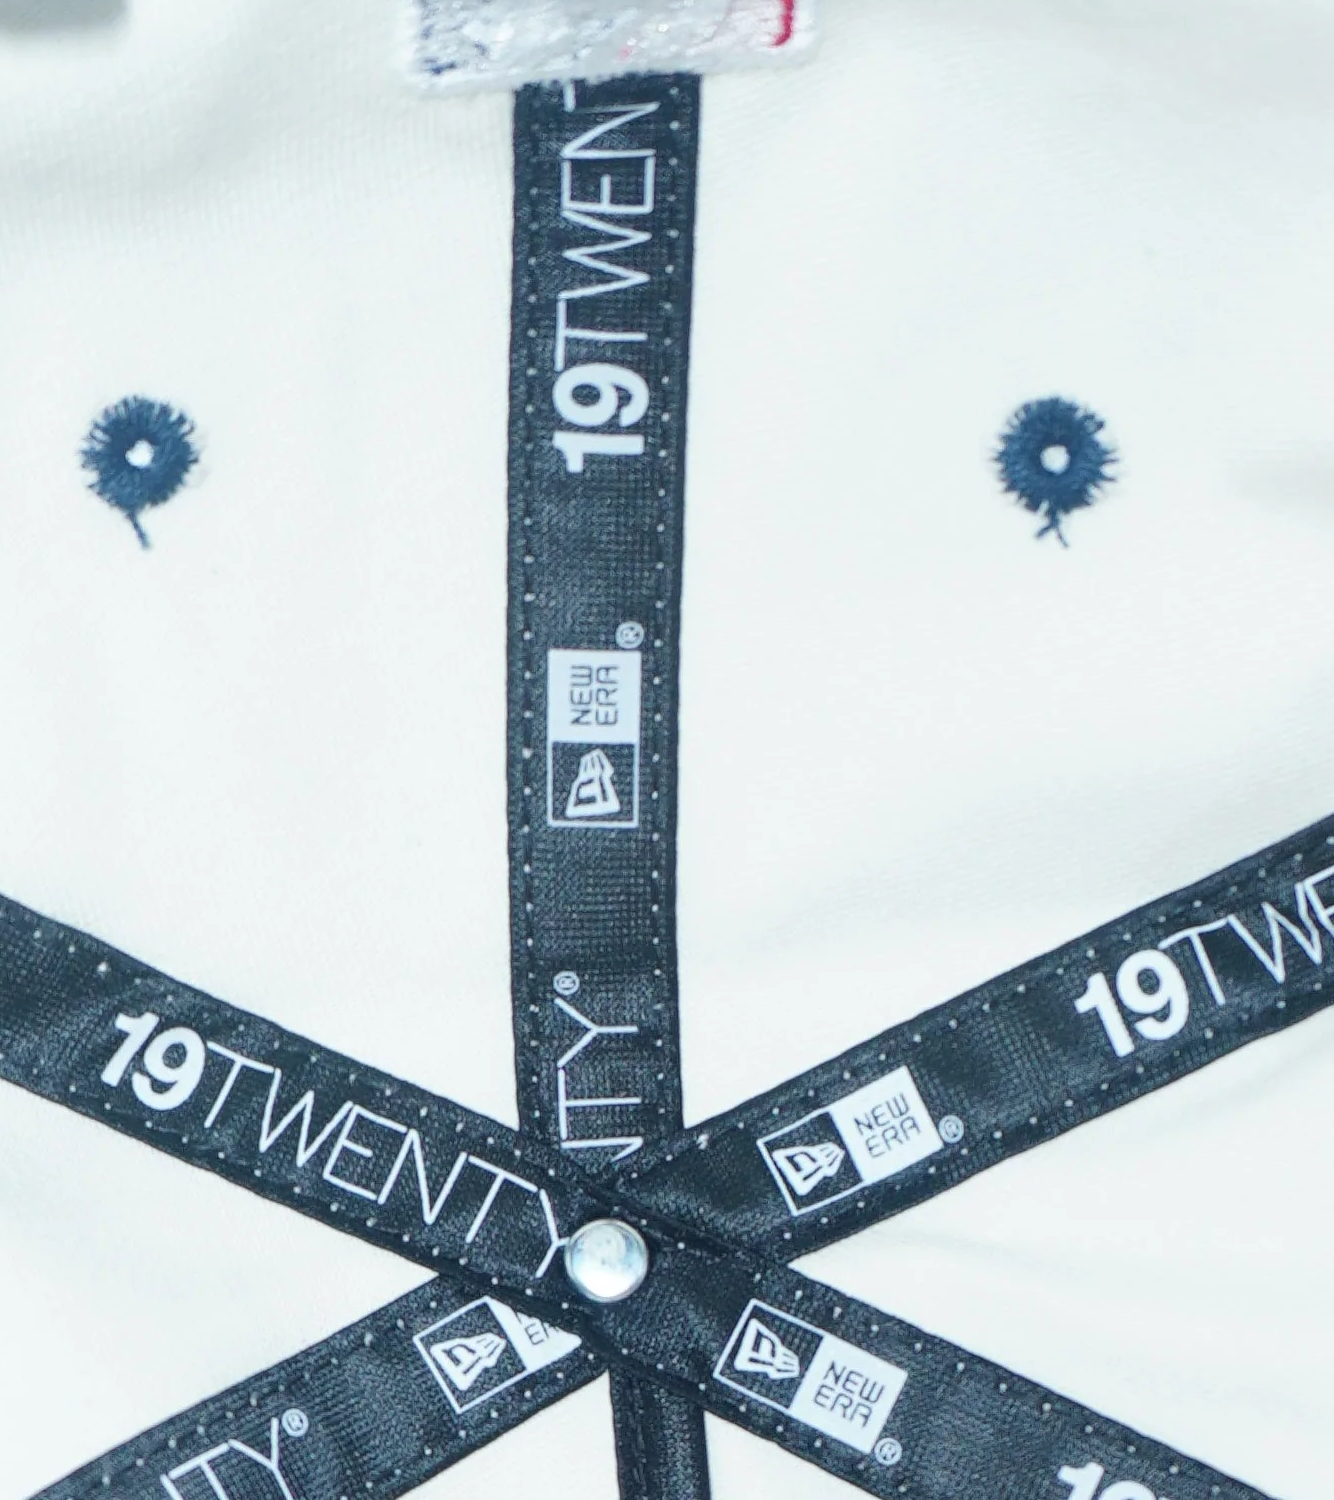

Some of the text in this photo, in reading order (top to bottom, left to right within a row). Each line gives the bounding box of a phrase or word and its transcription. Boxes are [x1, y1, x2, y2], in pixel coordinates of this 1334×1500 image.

[551, 83, 662, 474] 19TWEN
[570, 664, 593, 726] NEW
[595, 664, 620, 727] ERA
[853, 1091, 910, 1136] NEW
[865, 1115, 921, 1159] ERA
[101, 1011, 569, 1278] 19TWENTY
[813, 1383, 873, 1428] ERA
[823, 1360, 885, 1404] NEW
